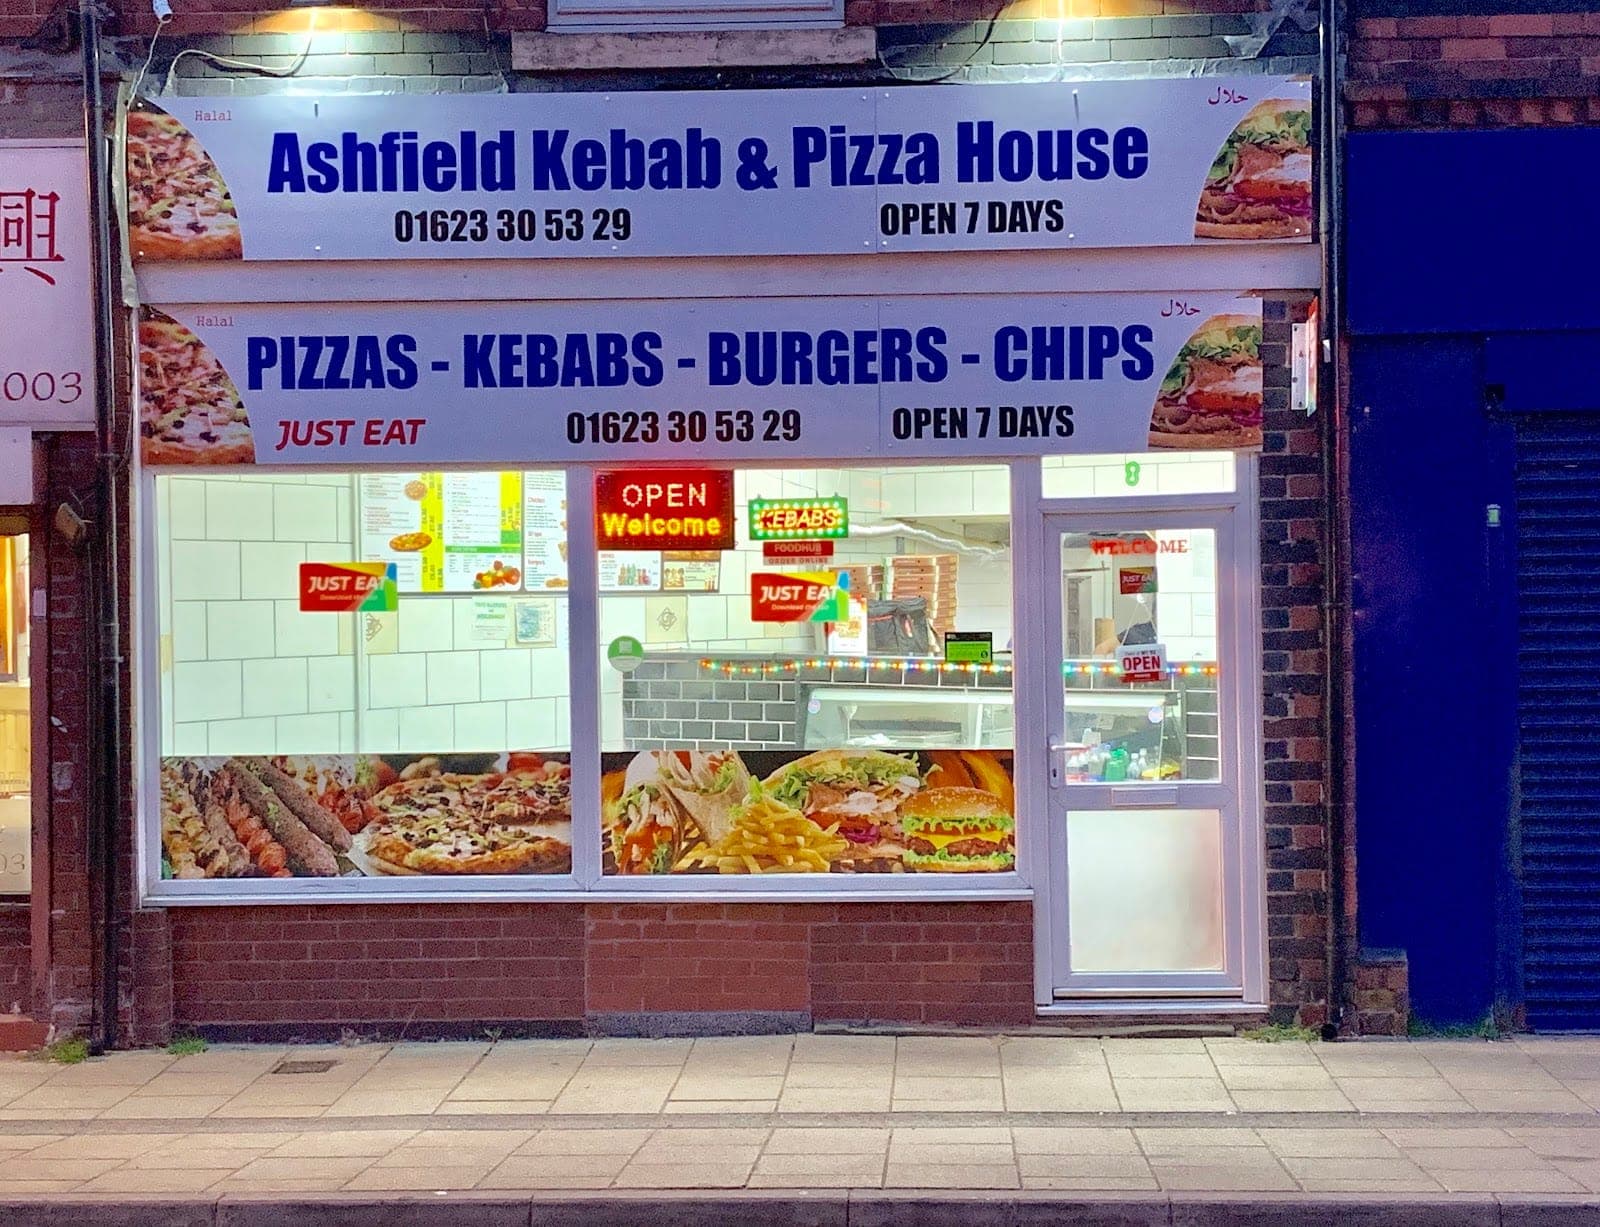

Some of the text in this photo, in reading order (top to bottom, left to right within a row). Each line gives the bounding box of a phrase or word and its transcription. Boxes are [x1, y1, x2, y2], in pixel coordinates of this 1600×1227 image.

[1208, 86, 1249, 105] حلال
[195, 110, 232, 121] Halal
[268, 121, 1148, 193] Ashfield Kebab & Pizza House
[395, 208, 630, 242] 01623 30 53 29
[881, 200, 1063, 235] OPEN 7 DAYS
[1161, 299, 1200, 317] حلال
[196, 315, 234, 327] Halal
[248, 334, 418, 390] PIZZAS
[464, 332, 663, 388] KEBABS
[709, 327, 948, 386] BURGERS
[994, 325, 1154, 382] CHIPS
[3, 372, 82, 404] 003
[567, 410, 801, 443] 01623 30 53 29
[893, 406, 1074, 439] OPEN 7 DAYS
[278, 420, 424, 448] JUST EAT
[622, 483, 707, 507] OPEN
[602, 512, 721, 536] Welcome
[759, 509, 839, 529] KEBABS
[774, 543, 822, 553] FOODHUB
[1091, 538, 1189, 554] WELCOME
[800, 557, 828, 565] ONLINE
[308, 576, 389, 594] JUST EAT
[759, 585, 838, 604] JUST EAT
[1122, 656, 1161, 671] OPEN
